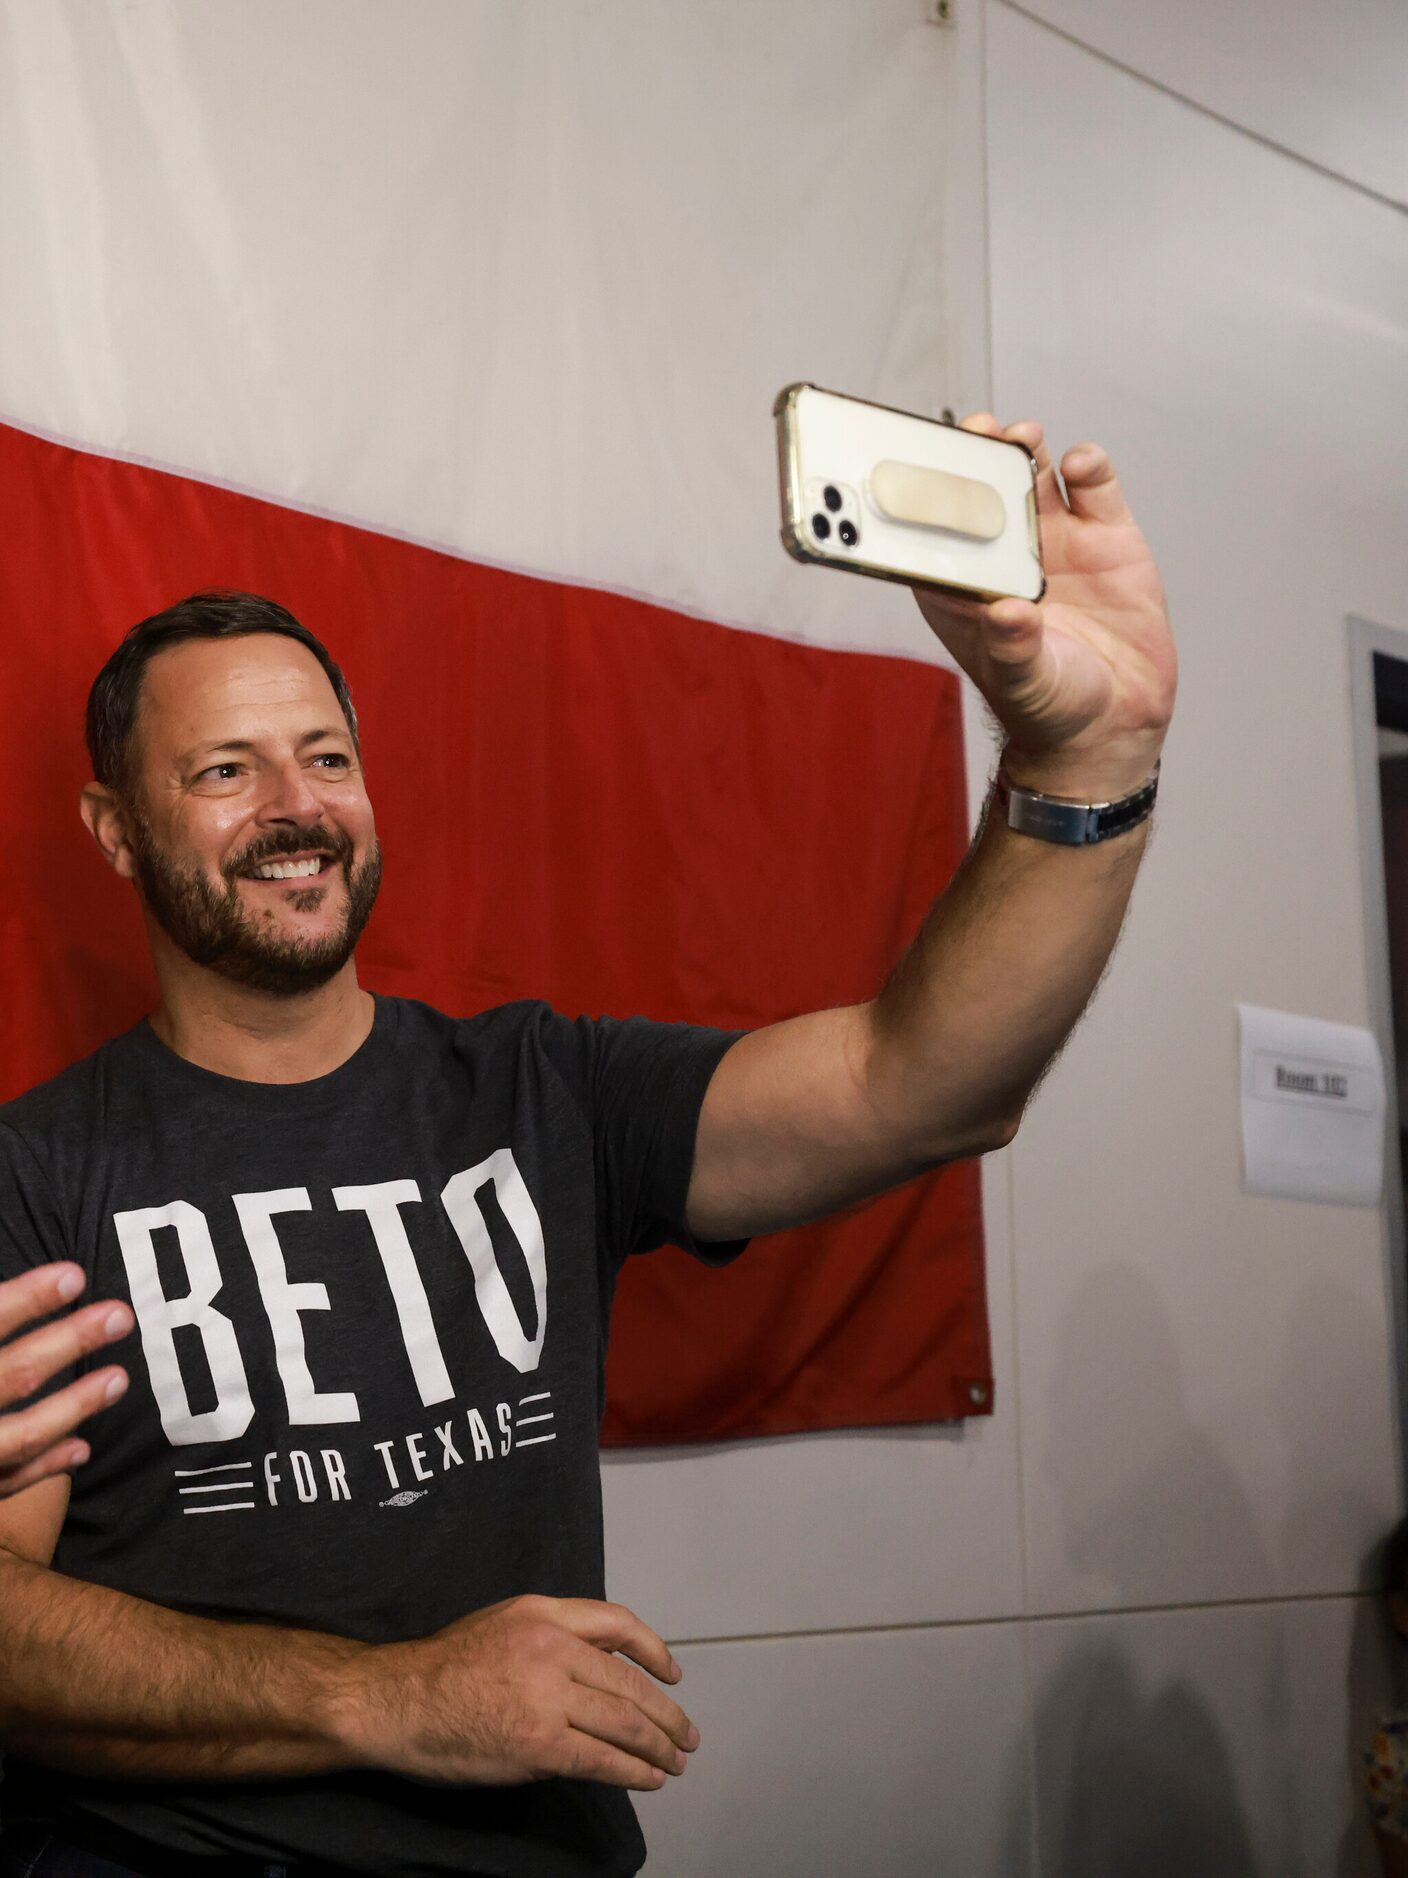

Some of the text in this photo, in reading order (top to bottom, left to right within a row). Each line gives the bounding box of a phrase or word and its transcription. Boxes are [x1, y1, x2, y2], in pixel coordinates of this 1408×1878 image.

[113, 1148, 548, 1446] BETO
[264, 1402, 513, 1506] FOR TEXAS
